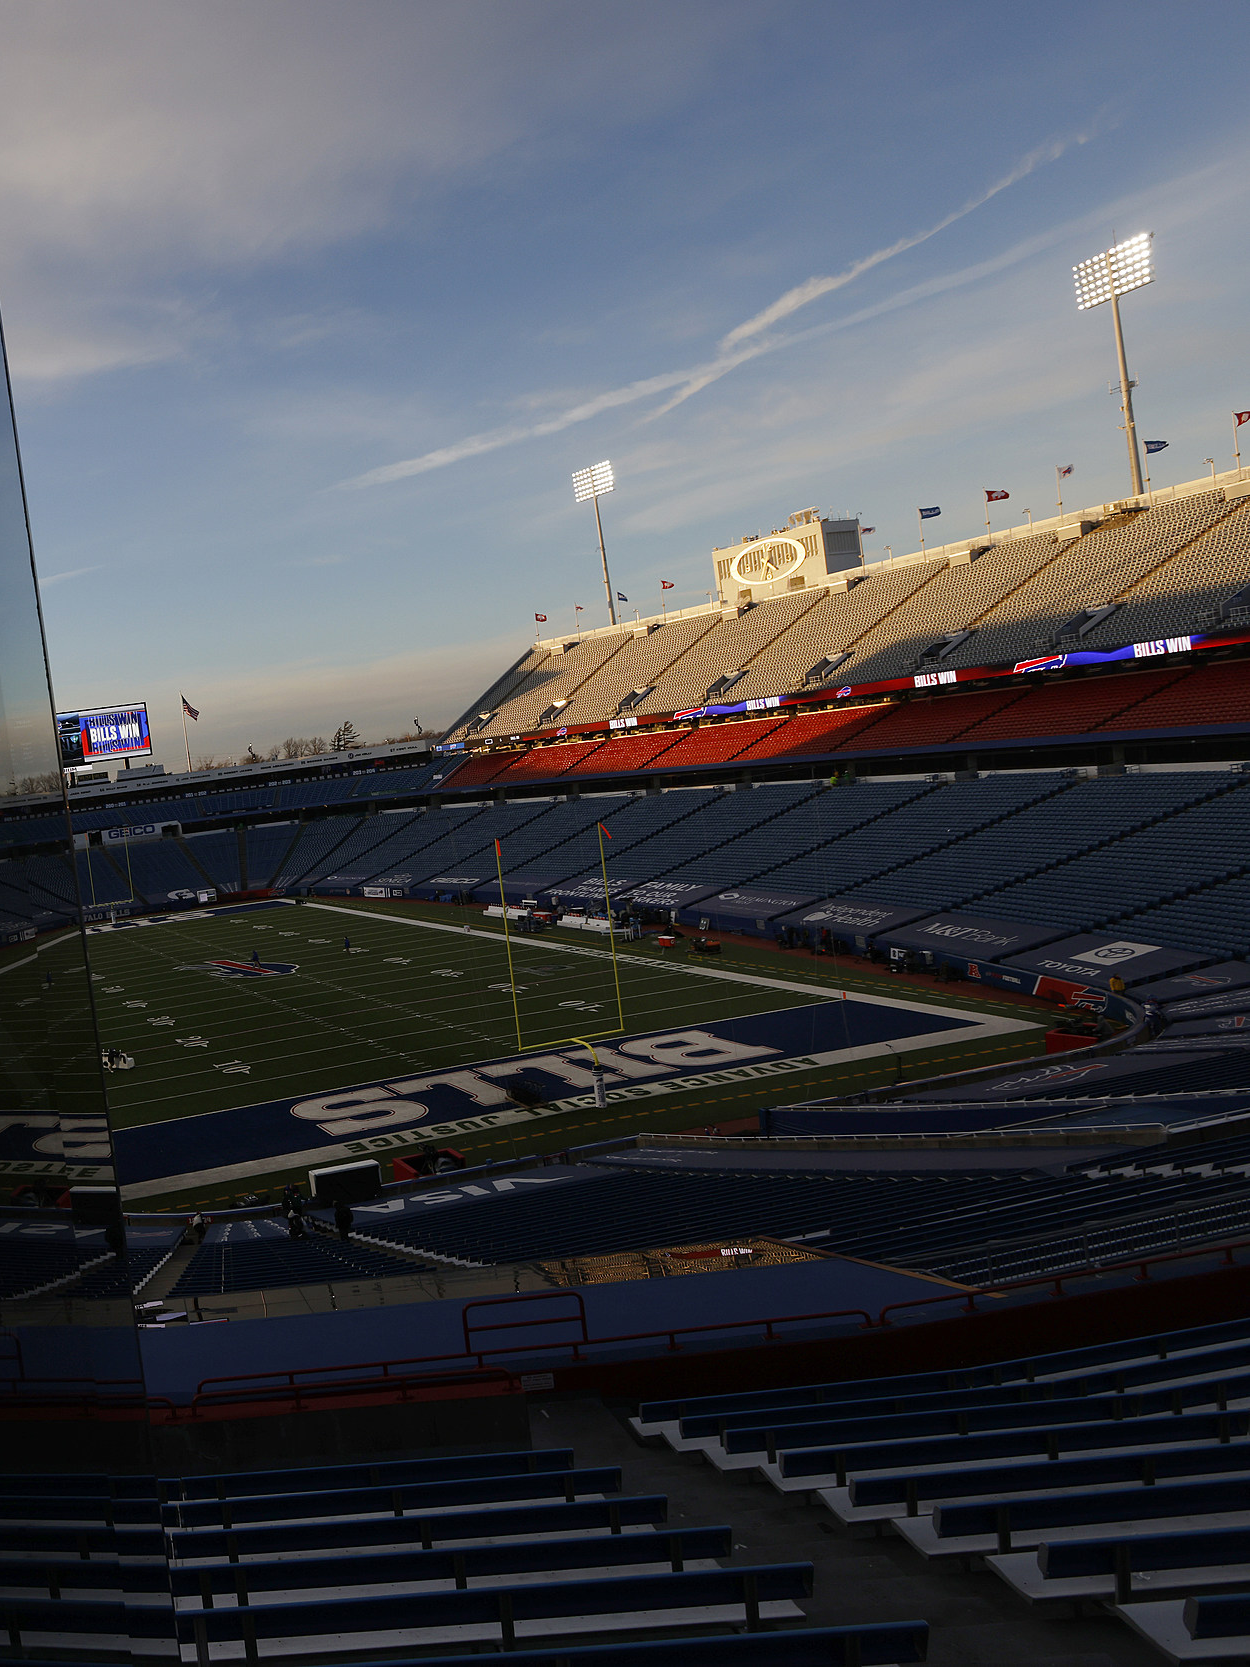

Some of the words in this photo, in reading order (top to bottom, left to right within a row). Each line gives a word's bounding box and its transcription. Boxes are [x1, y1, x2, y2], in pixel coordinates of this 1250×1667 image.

[1133, 640, 1165, 658] BILLS
[1166, 635, 1192, 654] WIN
[913, 673, 938, 688] BILLS
[937, 670, 957, 684] WIN
[746, 697, 765, 711] BILLS
[765, 696, 780, 708] WIN
[90, 726, 118, 743] BILLS
[119, 723, 141, 741] WIN
[108, 825, 155, 839] GEICO
[639, 881, 704, 892] FAMILY
[820, 902, 895, 919] Independent
[825, 913, 883, 928] Health
[968, 928, 1020, 947] Bank
[1036, 959, 1102, 977] TOYOTA
[212, 1060, 252, 1075] 10
[658, 1057, 820, 1091] ADVANCE
[290, 1029, 784, 1137] BILLS
[513, 1087, 652, 1118] SOCIAL
[343, 1114, 501, 1155] JUSTICE
[350, 1176, 575, 1213] VISA
